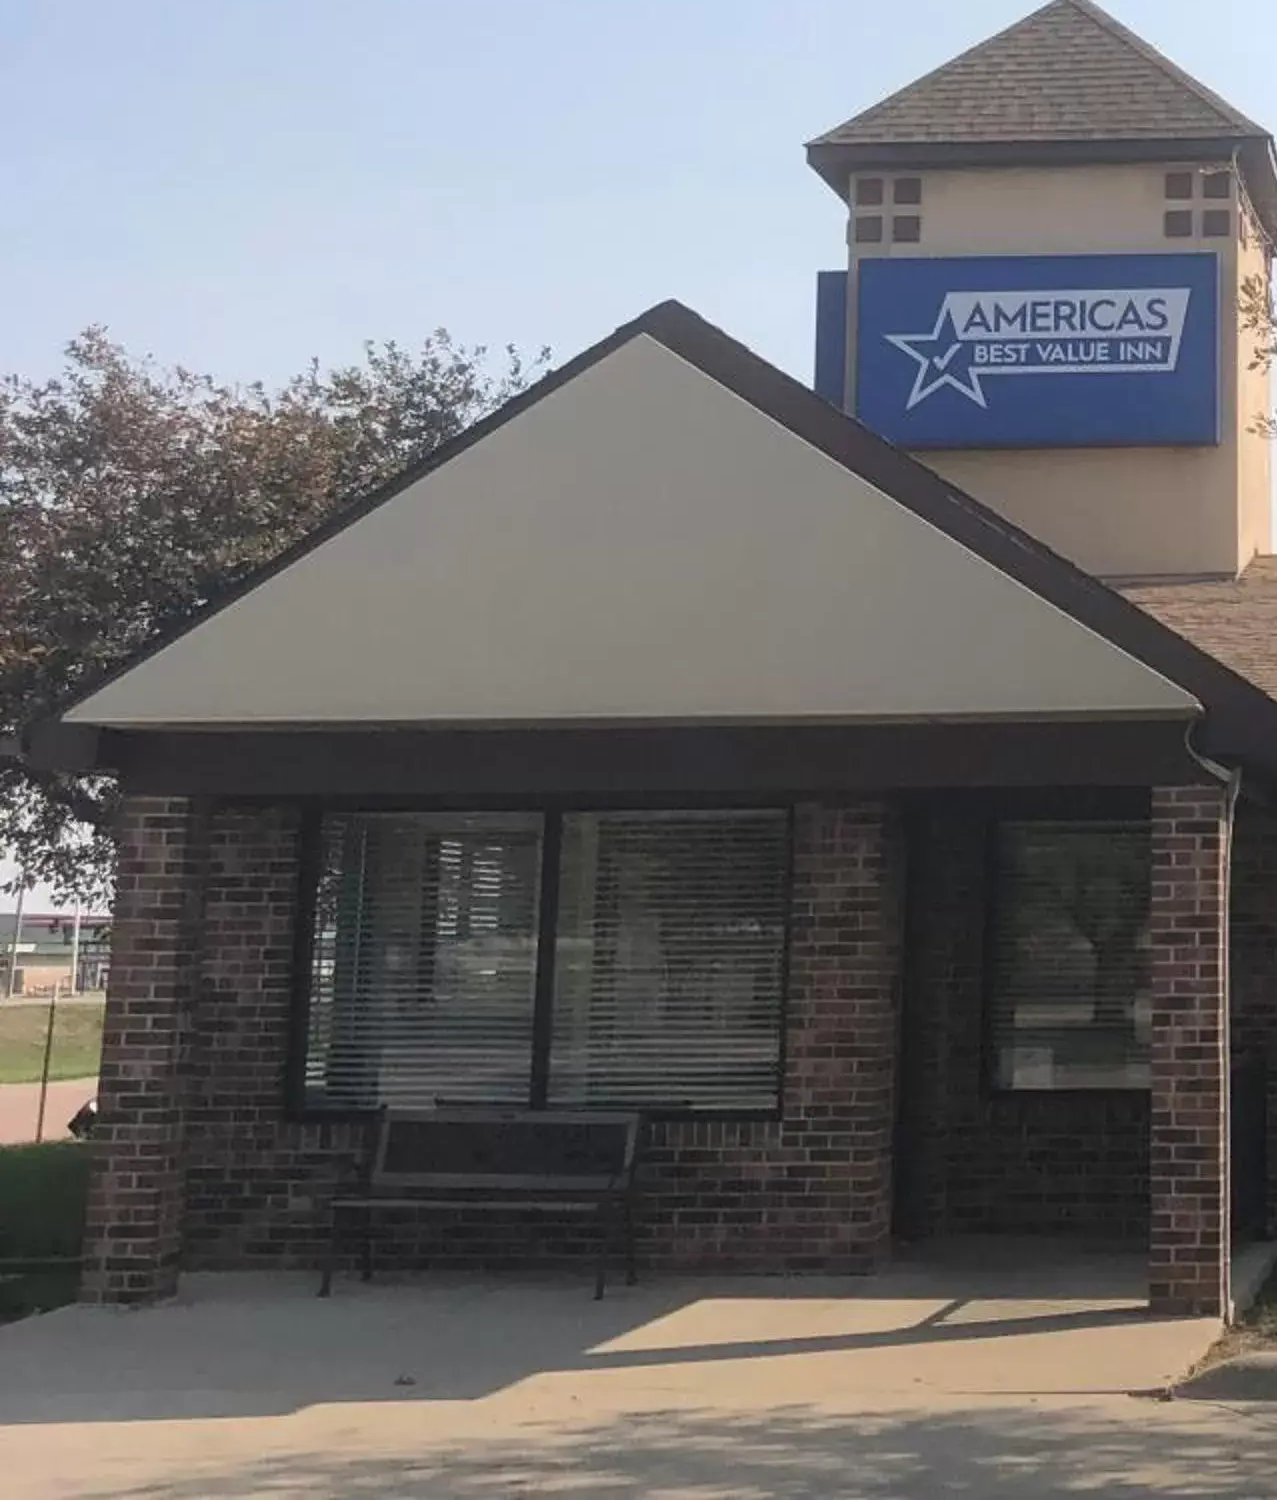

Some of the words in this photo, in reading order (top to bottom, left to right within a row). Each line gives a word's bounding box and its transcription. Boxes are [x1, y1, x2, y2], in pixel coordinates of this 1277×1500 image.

[963, 298, 1168, 333] AMERICAS
[974, 343, 1030, 363] BEST
[1036, 343, 1109, 362] VALUE
[1119, 342, 1163, 361] INN
